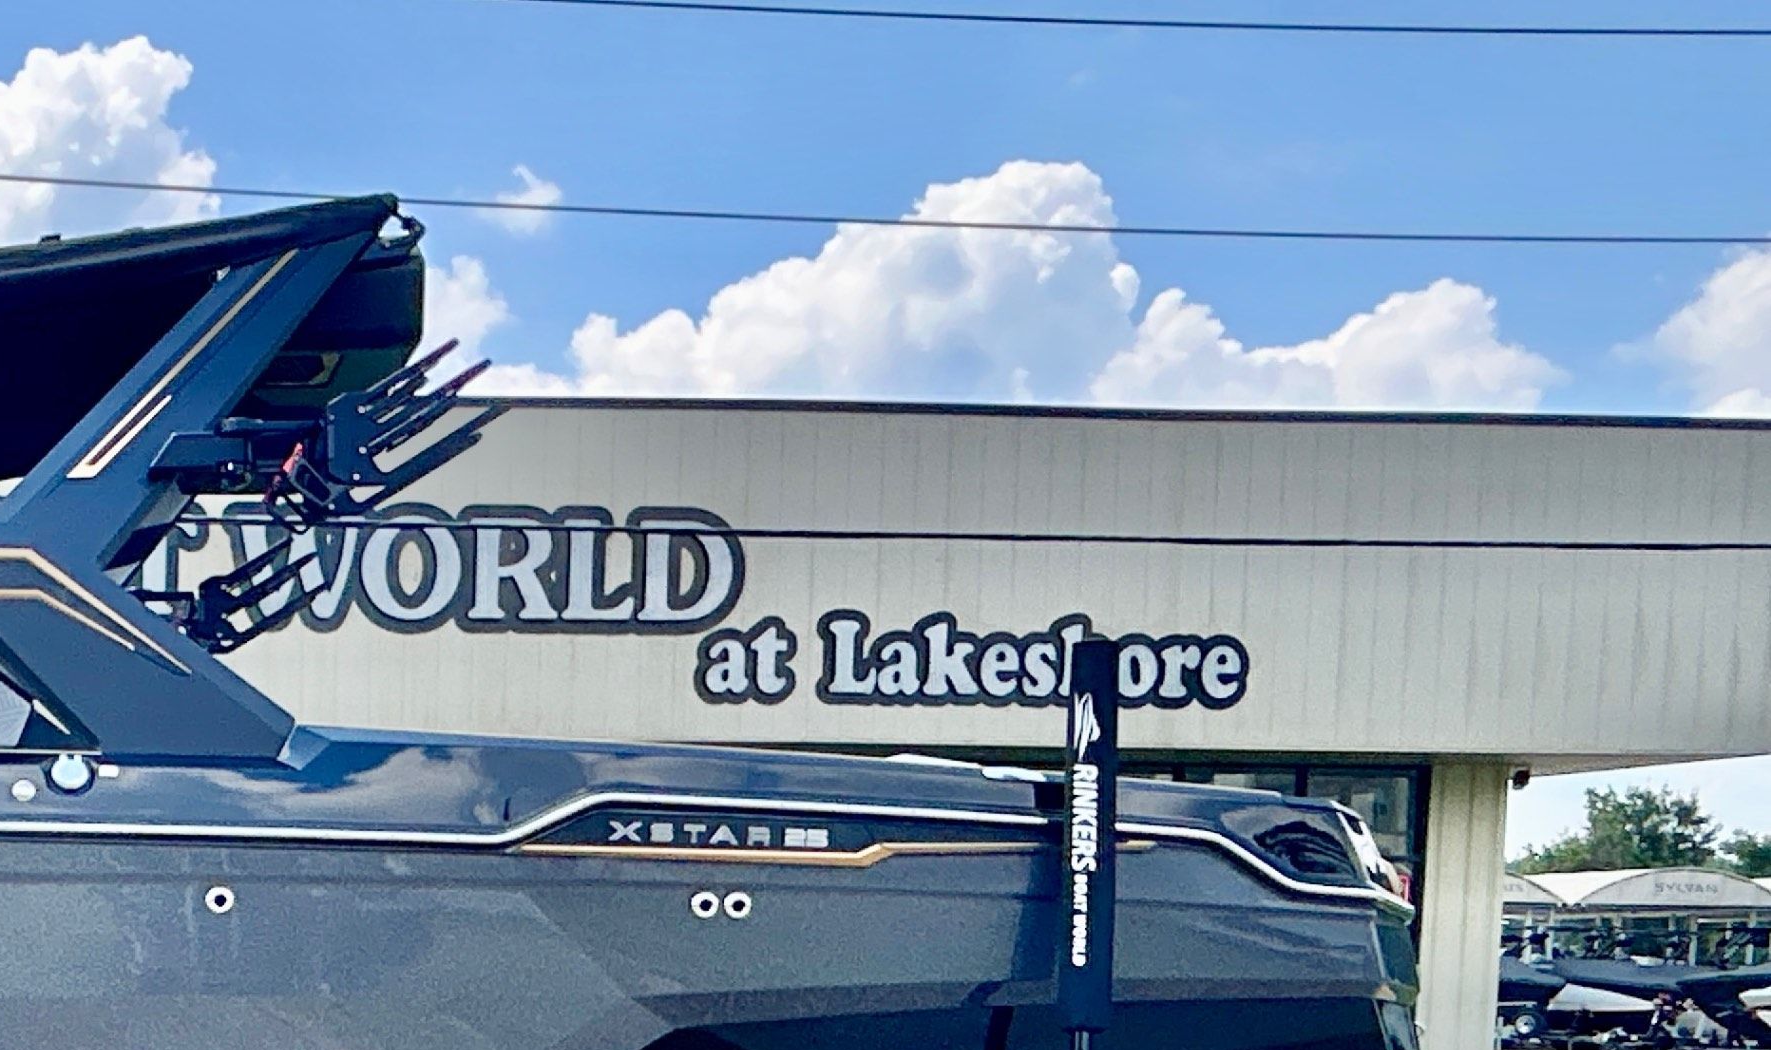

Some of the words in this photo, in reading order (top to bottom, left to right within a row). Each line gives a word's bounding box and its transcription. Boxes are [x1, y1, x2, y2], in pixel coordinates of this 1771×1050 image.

[703, 625, 793, 696] at
[1071, 763, 1099, 872] RINKERS
[1654, 881, 1719, 895] SYLVAN
